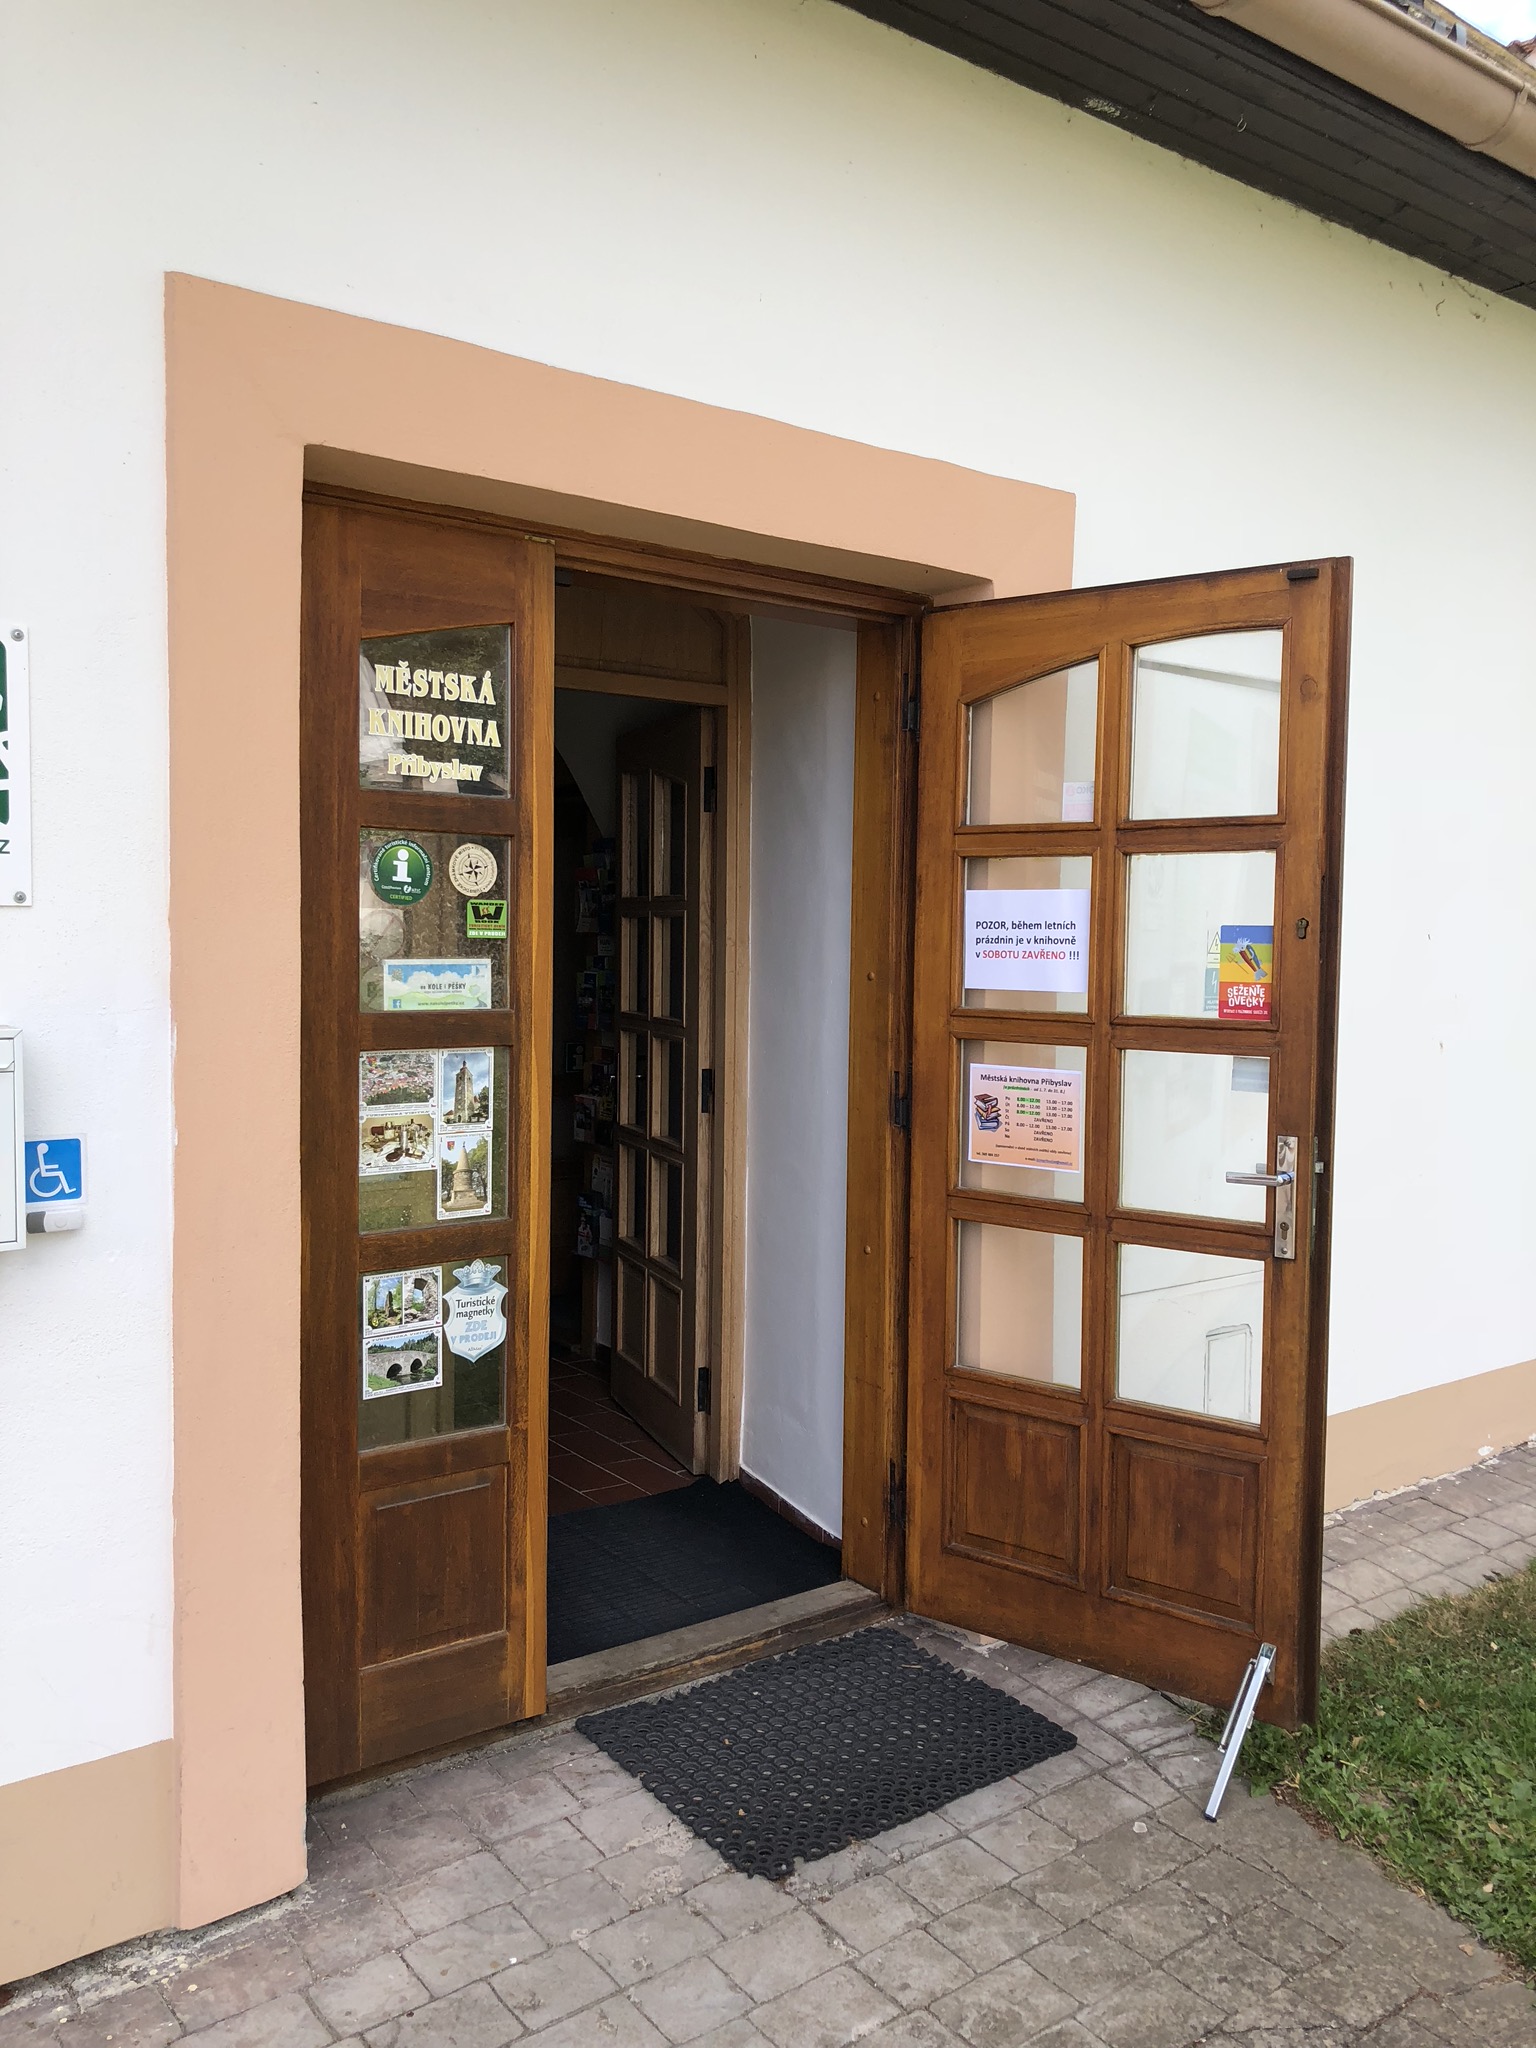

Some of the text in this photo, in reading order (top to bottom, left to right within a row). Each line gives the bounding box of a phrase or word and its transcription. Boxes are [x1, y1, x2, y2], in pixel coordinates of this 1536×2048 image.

[374, 660, 496, 705] MĚSTSKÁ
[368, 708, 501, 747] KNIHOVNA
[387, 753, 483, 783] Přibyslav
[975, 921, 1076, 931] POZOR, během letních
[975, 935, 1013, 945] prázdnin
[1015, 936, 1024, 946] je
[1034, 936, 1076, 945] knihovně
[982, 950, 1019, 958] SOBOTU
[1022, 949, 1066, 960] ZAVŘENO
[1069, 951, 1079, 960] !!!
[1228, 984, 1265, 997] SEŽEŇTE
[1229, 995, 1265, 1007] OVEČKY
[980, 1074, 1072, 1087] Městská knihovna Přibyslav
[456, 1296, 495, 1308] Turistické
[456, 1306, 495, 1320] magnetky
[465, 1320, 487, 1332] ZDE
[451, 1331, 496, 1344] V PRODEJI
